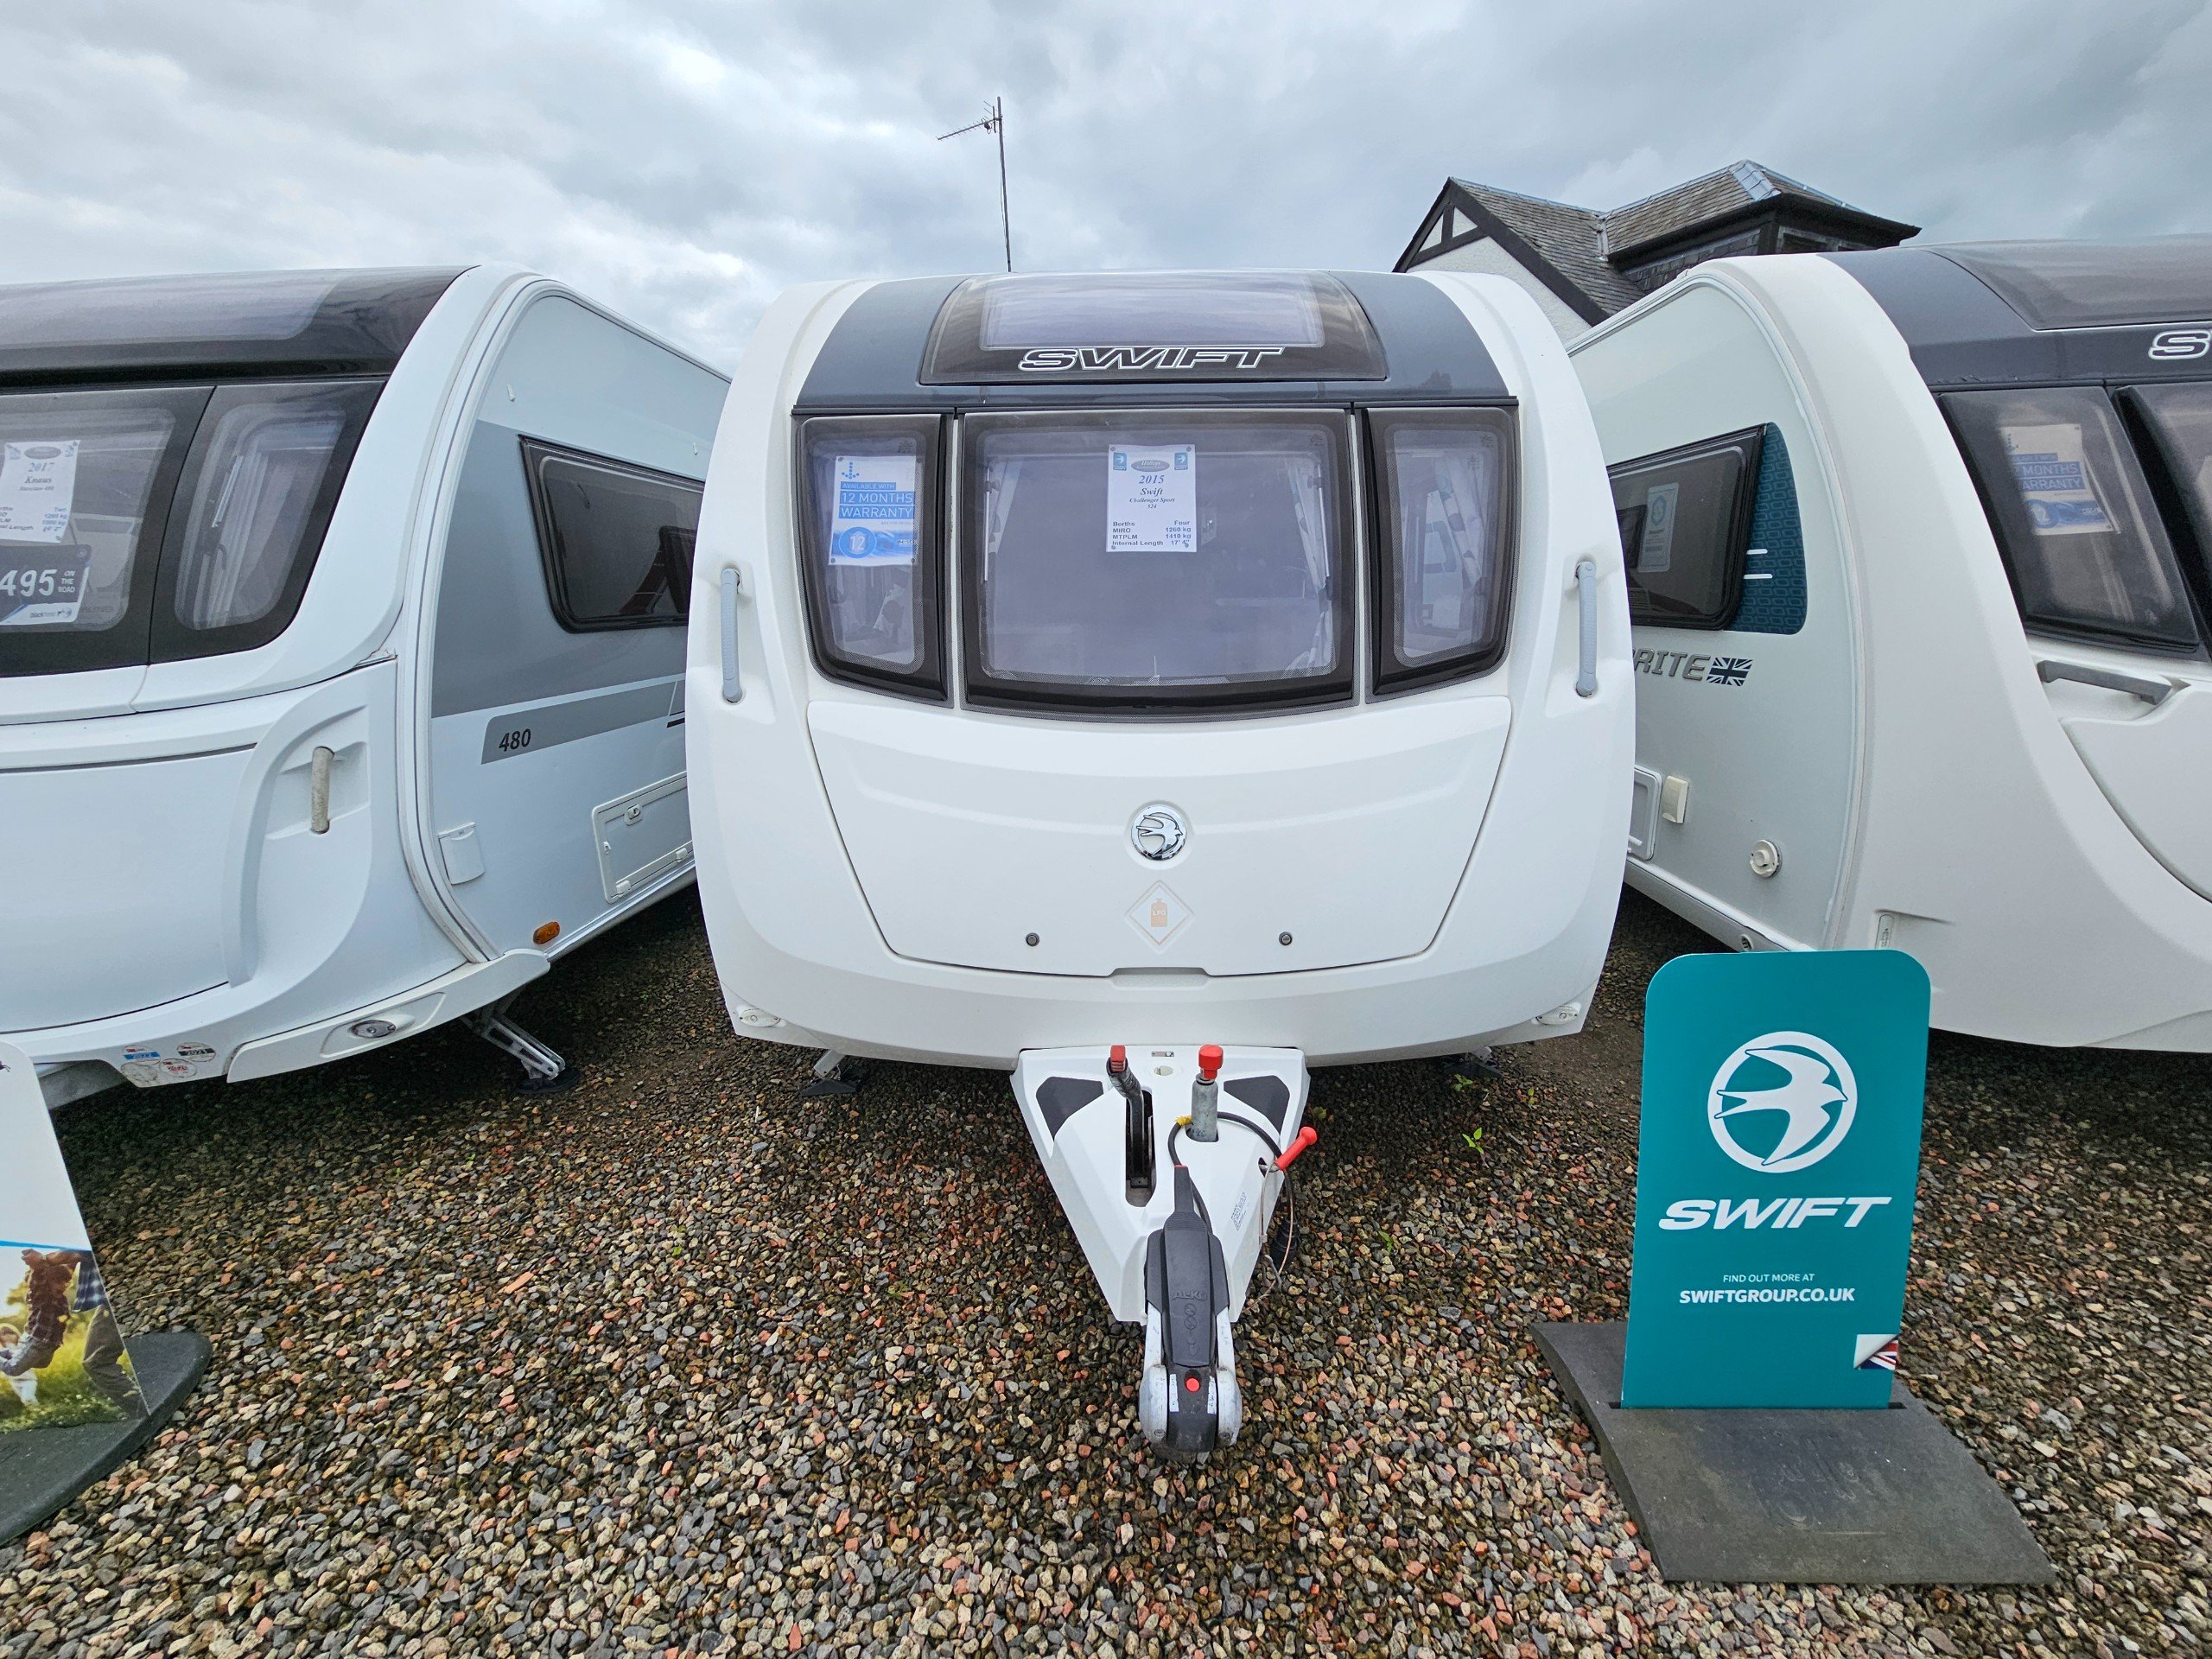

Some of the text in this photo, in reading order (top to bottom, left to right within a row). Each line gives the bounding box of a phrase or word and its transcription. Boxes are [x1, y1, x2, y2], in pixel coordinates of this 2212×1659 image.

[1018, 346, 1285, 372] SWIFT
[2023, 464, 2078, 475] MONTHS
[1139, 474, 1165, 484] 2015
[2022, 478, 2082, 491] ARRANTY
[842, 493, 912, 504] 12 MONTHS
[1141, 487, 1163, 497] Swift
[841, 507, 912, 518] WARRANTY
[849, 536, 865, 550] 12
[1632, 647, 1712, 682] RITE
[499, 728, 532, 753] 480
[1658, 1196, 1892, 1230] SWIFT
[1723, 1273, 1815, 1283] FIND OUT MORE AT
[1679, 1287, 1856, 1304] SWIFTGROUP.CO.UK
